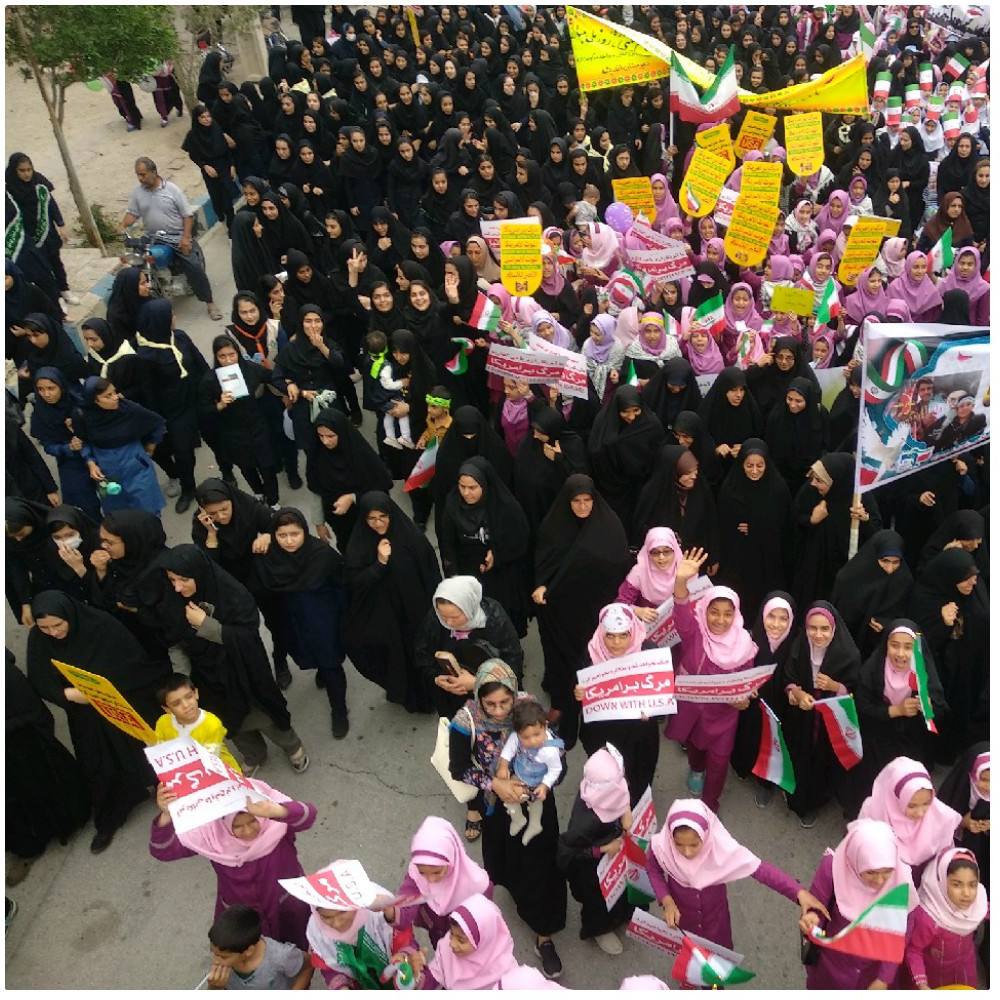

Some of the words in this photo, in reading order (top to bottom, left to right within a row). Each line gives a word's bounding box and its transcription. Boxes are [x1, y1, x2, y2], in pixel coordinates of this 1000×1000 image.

[622, 680, 640, 694] بر
[641, 674, 671, 692] مرگ
[585, 701, 617, 715] DOWN
[620, 698, 646, 710] WITH
[165, 769, 204, 790] مرگ
